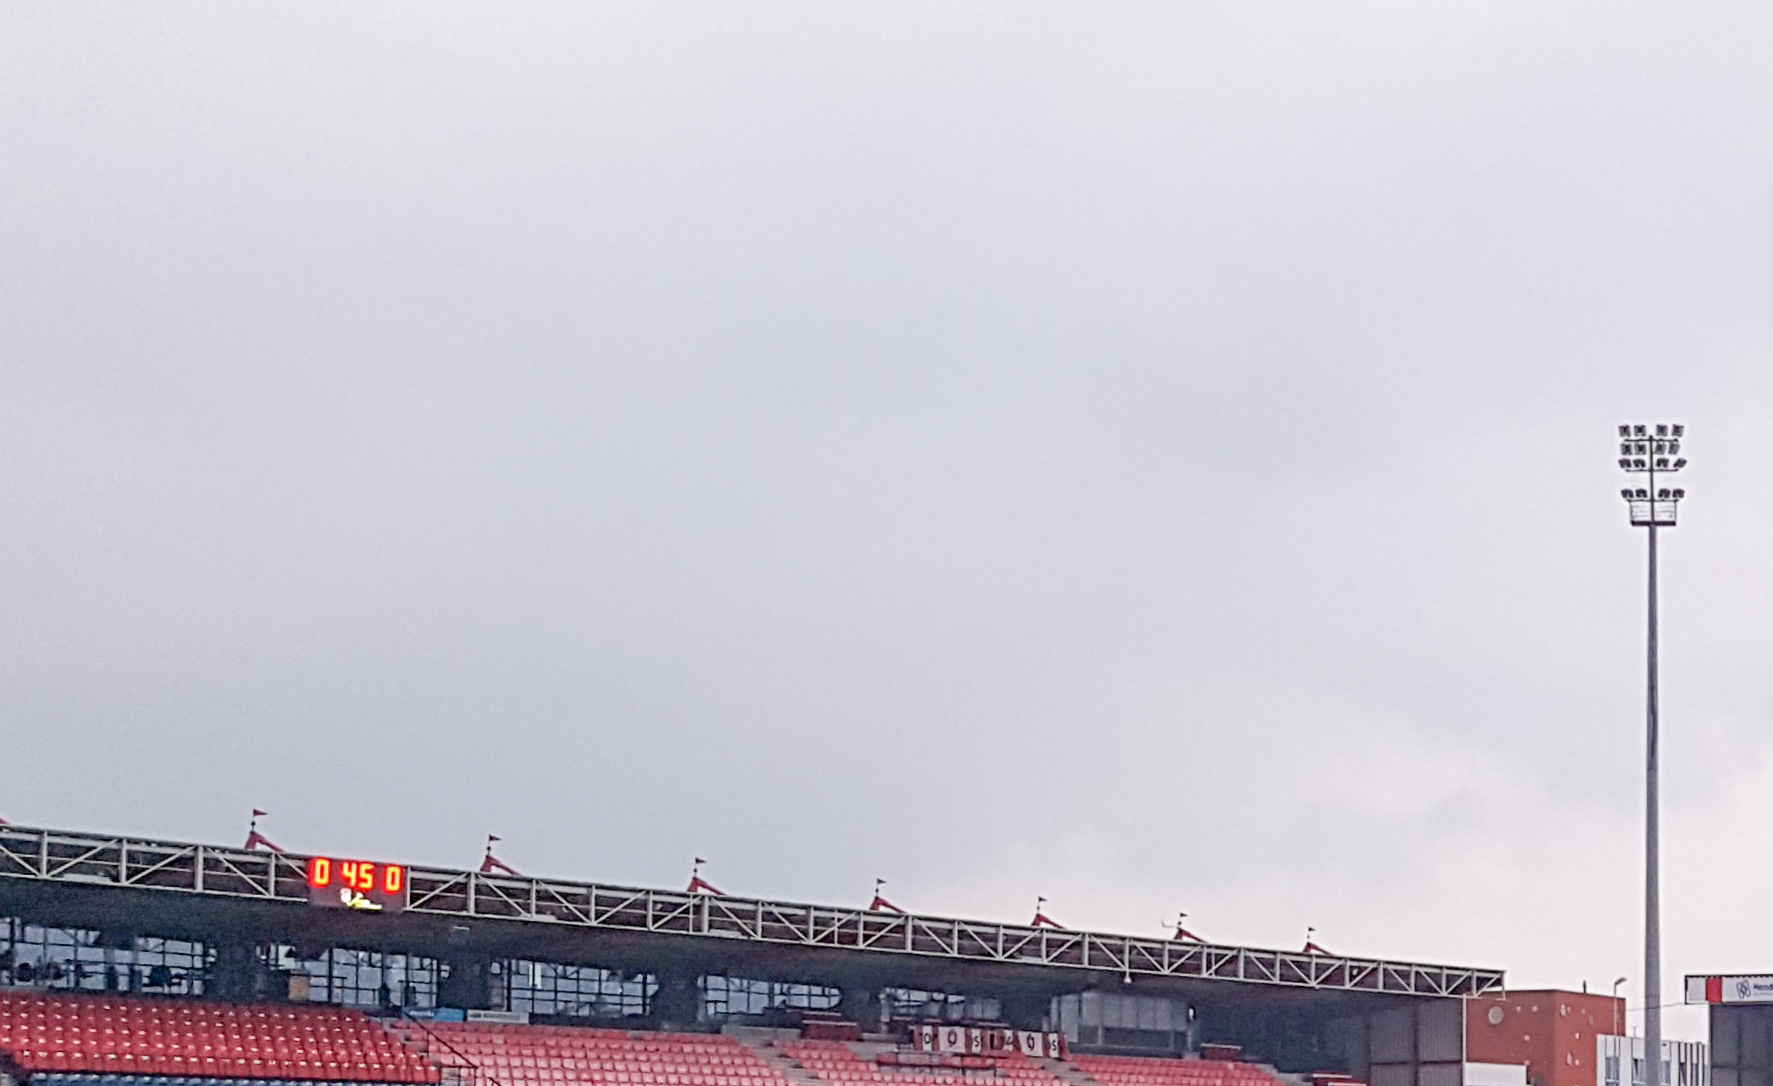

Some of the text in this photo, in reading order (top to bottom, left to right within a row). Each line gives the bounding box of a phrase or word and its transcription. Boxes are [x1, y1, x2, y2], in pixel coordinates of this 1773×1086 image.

[314, 858, 401, 891] 0 45 0
